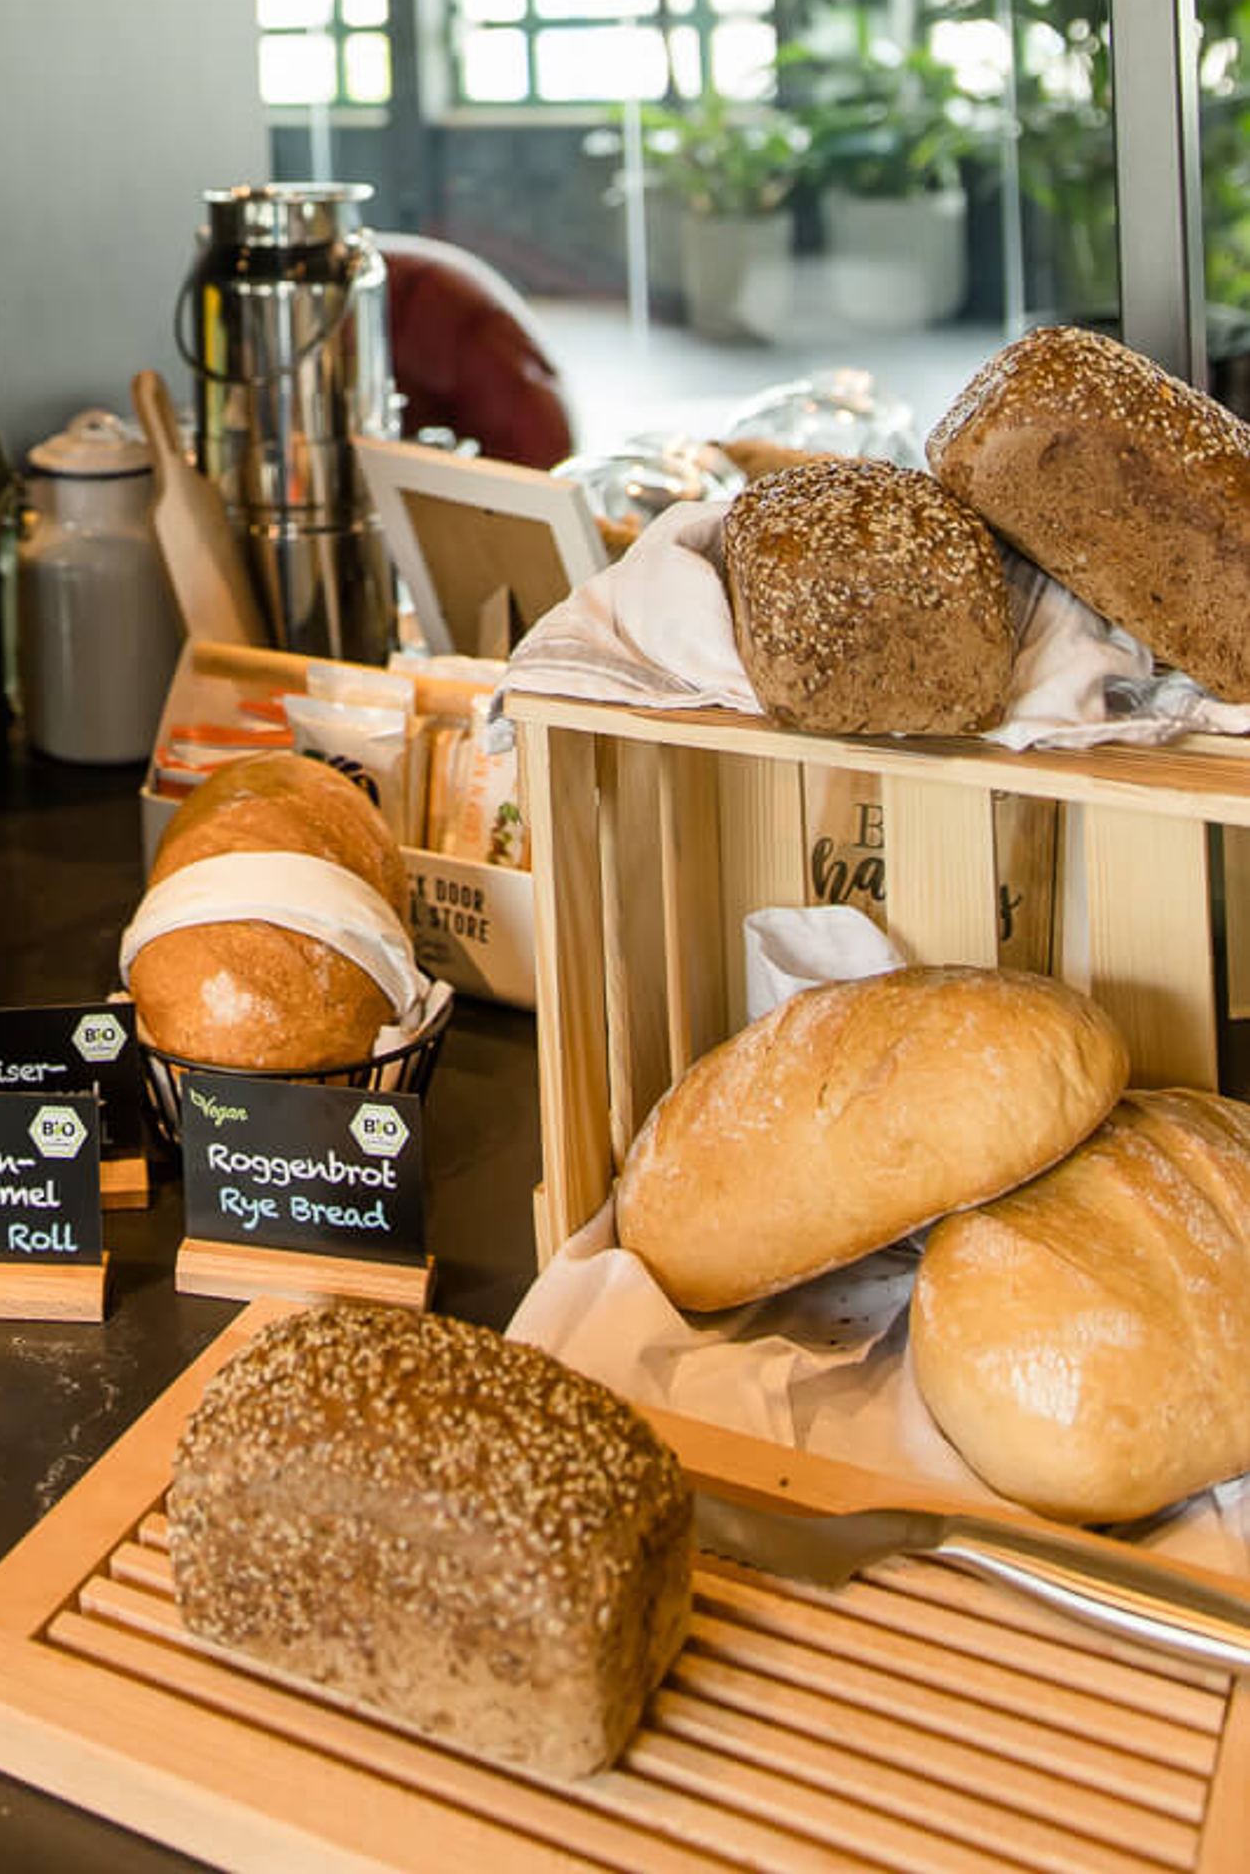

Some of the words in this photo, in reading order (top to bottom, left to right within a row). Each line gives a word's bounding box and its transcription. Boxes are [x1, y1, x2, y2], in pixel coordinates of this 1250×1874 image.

[435, 877, 484, 913] DOOR
[429, 905, 490, 944] STORE
[190, 1087, 249, 1127] Vegan
[207, 1142, 399, 1190] Roggenbrot
[219, 1186, 279, 1231] Rye
[290, 1196, 391, 1231] Bread
[8, 1221, 78, 1253] Roll
